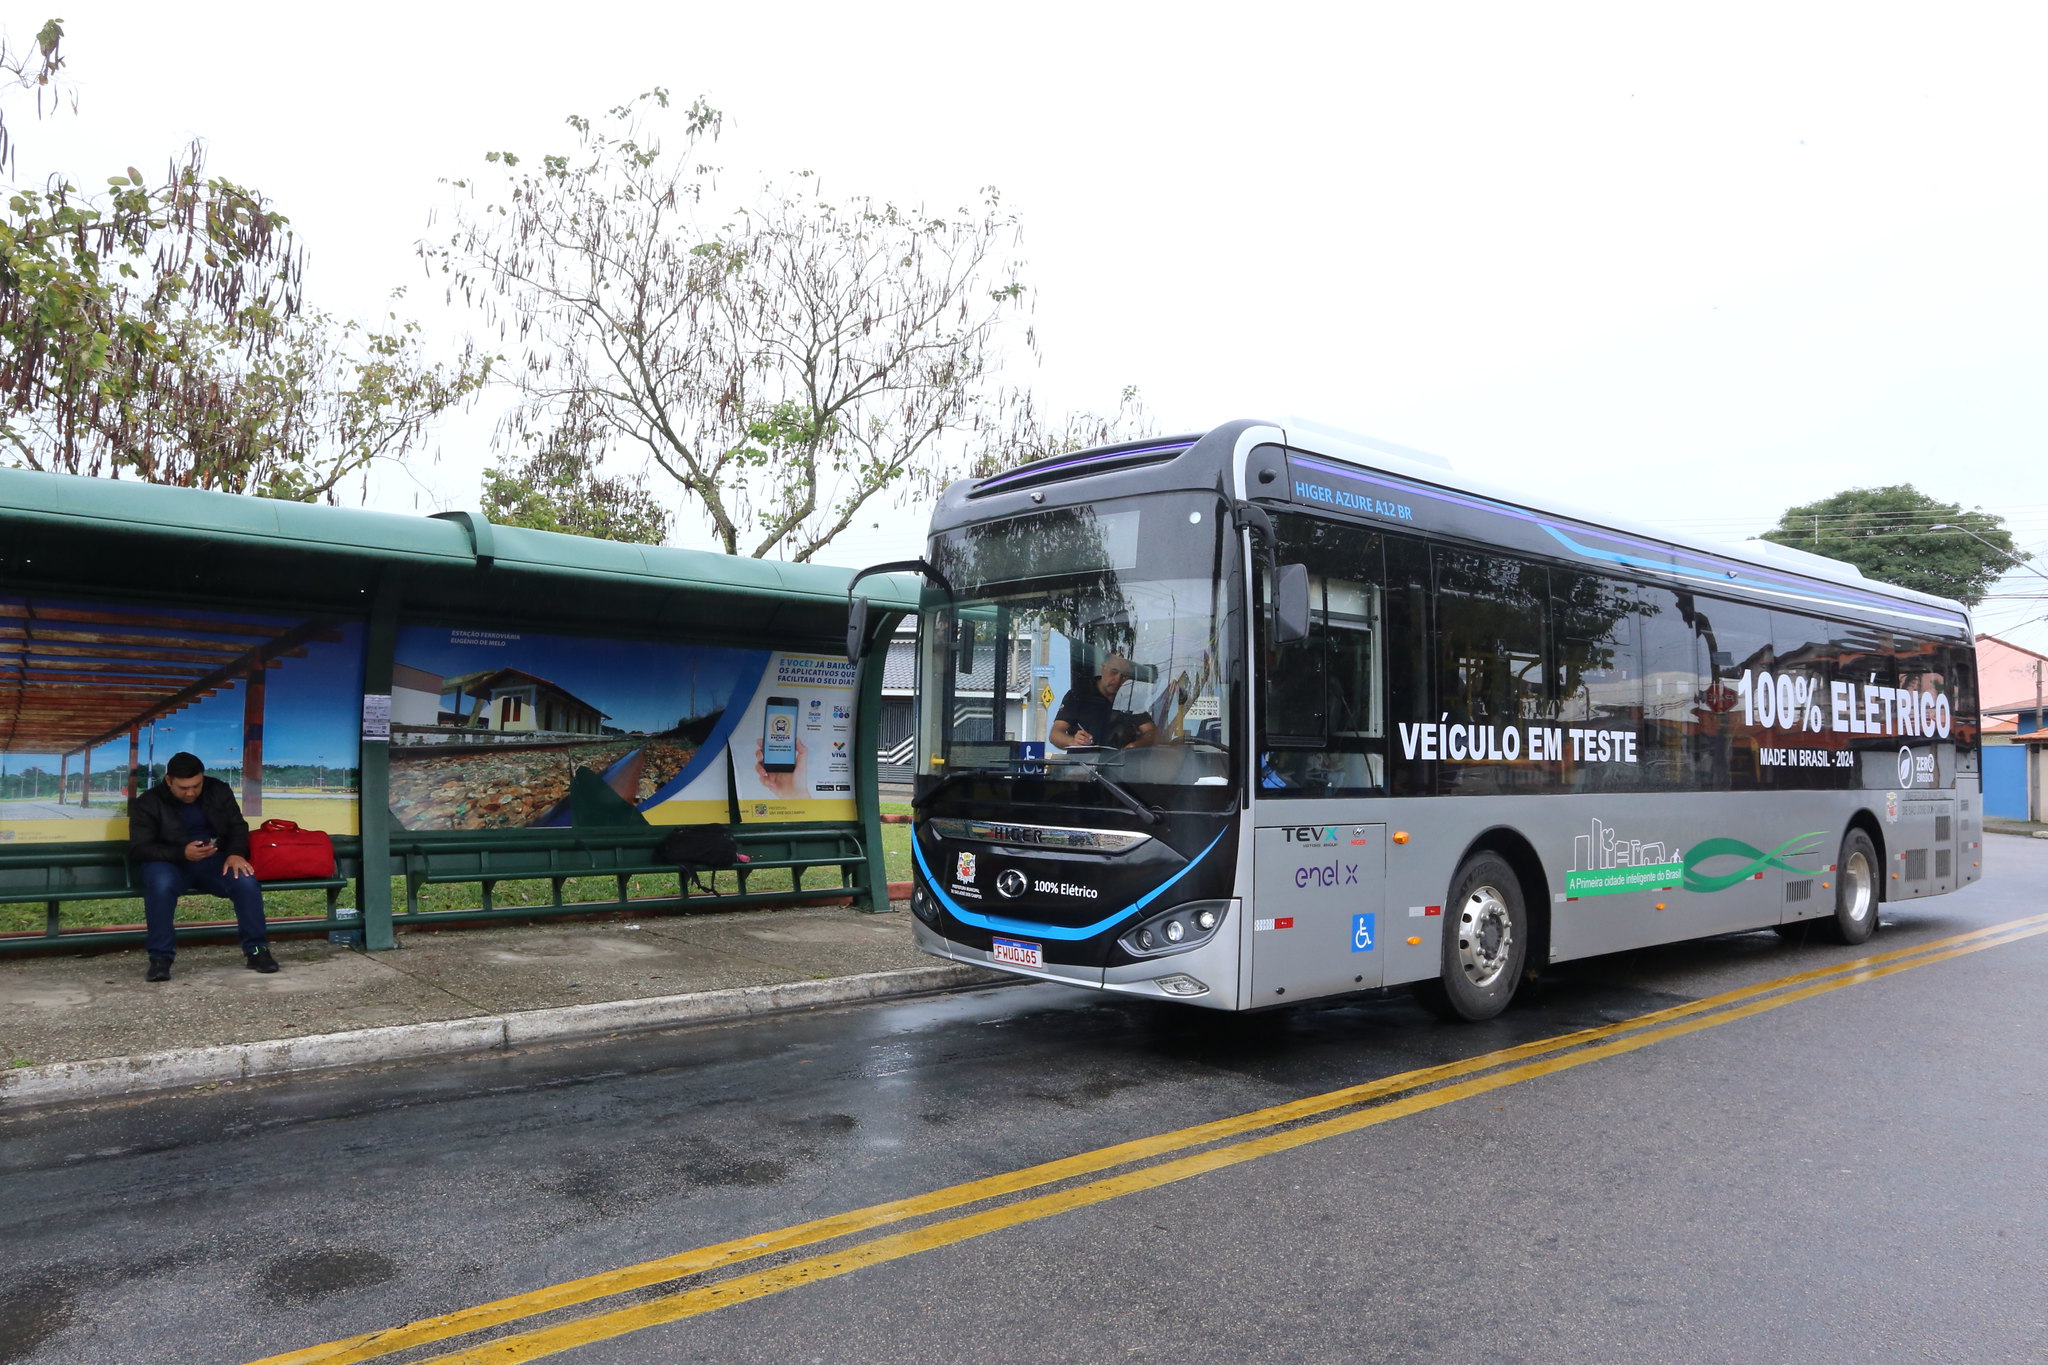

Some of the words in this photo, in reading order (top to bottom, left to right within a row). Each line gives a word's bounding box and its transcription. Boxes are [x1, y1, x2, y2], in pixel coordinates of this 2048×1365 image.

[1295, 481, 1334, 504] HIGER
[1335, 491, 1374, 513] AZURE
[1375, 500, 1397, 517] A12
[1398, 504, 1413, 521] BR
[780, 658, 785, 666] E
[787, 659, 814, 667] VOCÊ?
[815, 660, 825, 668] JÁ
[791, 668, 839, 677] APLICATIVOS
[777, 675, 815, 683] FACILITAM
[1738, 669, 1822, 734] 100%
[1830, 672, 1951, 739] ELÉTRICO
[1398, 712, 1520, 761] VEÍCULO
[1528, 727, 1563, 761] EM
[1568, 728, 1637, 763] TESTE
[1760, 748, 1787, 766] MADE
[1788, 749, 1798, 766] IN
[1799, 749, 1831, 767] BRASIL
[1836, 751, 1854, 767] 2024
[1916, 754, 1935, 772] ZERO
[994, 826, 1042, 843] HIGER
[1281, 827, 1338, 842] TEVX
[1295, 859, 1339, 888] enel
[1569, 878, 1576, 890] A
[1576, 876, 1603, 889] Primeira
[1604, 874, 1625, 887] cidade
[1626, 871, 1656, 885] inteligente
[1656, 871, 1665, 881] do
[1665, 868, 1682, 880] Brasil
[1034, 880, 1059, 894] 100%
[1060, 883, 1098, 899] Elétrico
